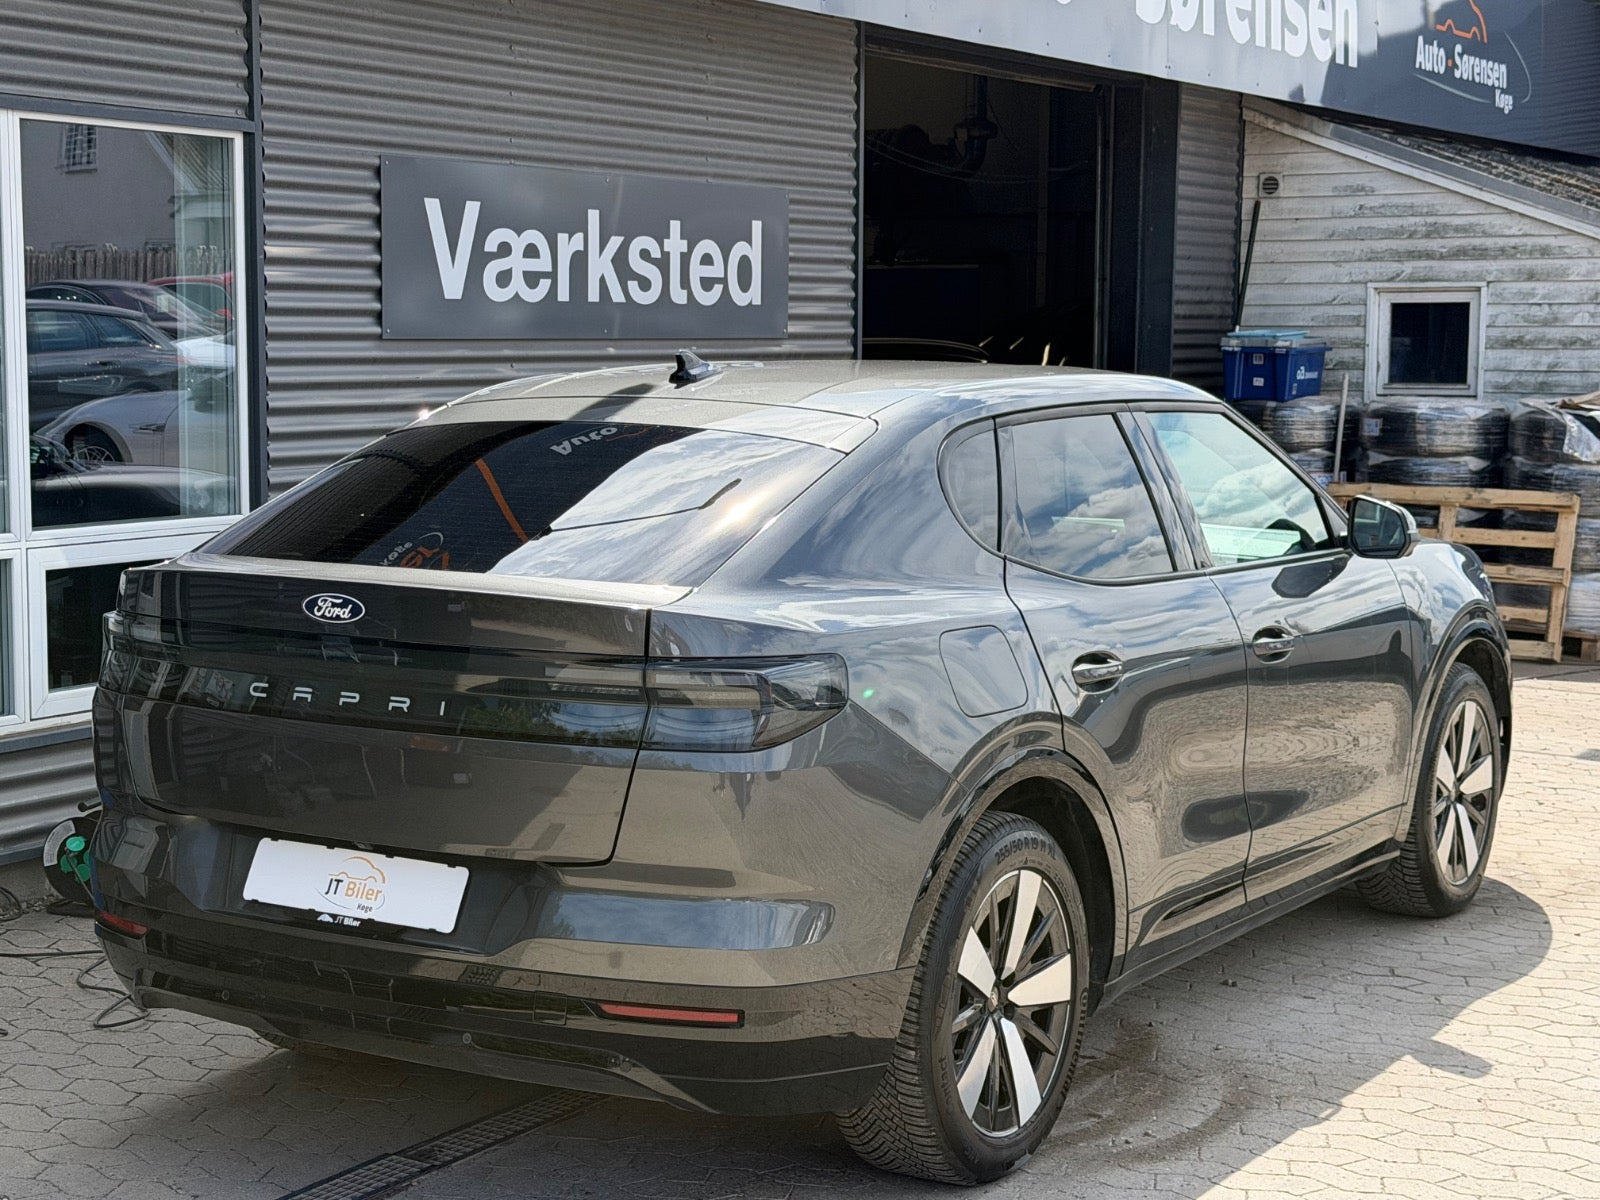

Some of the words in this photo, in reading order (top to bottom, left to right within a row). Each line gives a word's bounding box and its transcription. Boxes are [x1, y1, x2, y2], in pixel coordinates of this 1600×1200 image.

[1136, 0, 1358, 68] ensen
[1415, 35, 1446, 74] Auto
[1454, 43, 1507, 89] Sørensen
[1495, 88, 1513, 114] Køge
[423, 197, 762, 306] Værksted
[314, 596, 352, 619] Ford
[249, 682, 446, 716] CAPRI
[324, 878, 344, 895] JT
[344, 880, 382, 901] Biler
[357, 902, 373, 913] Køge
[334, 916, 344, 924] JT
[344, 916, 361, 927] Biler
